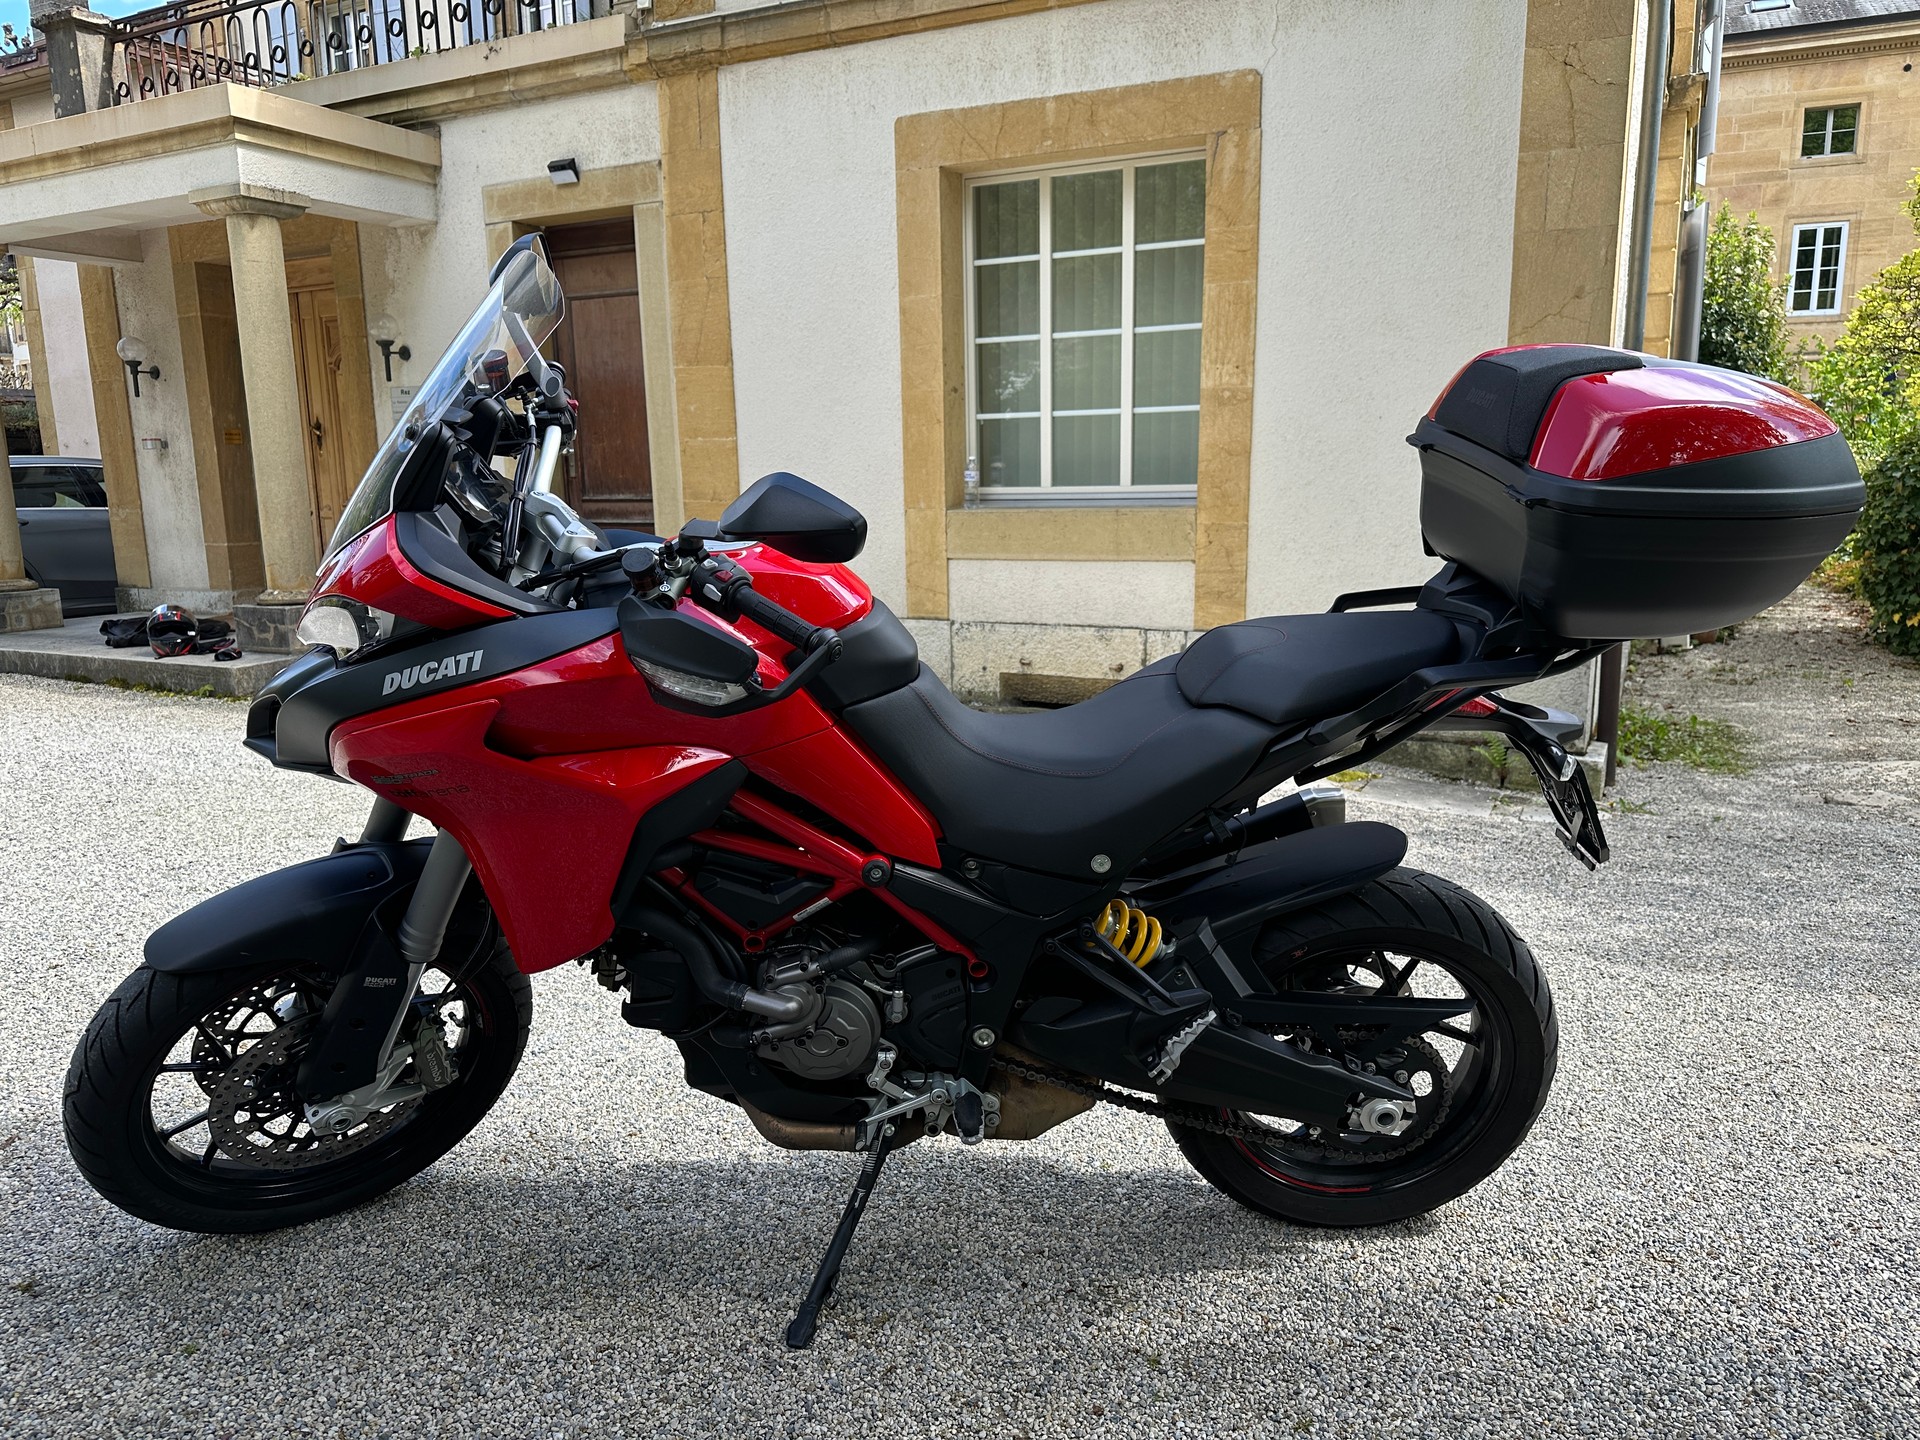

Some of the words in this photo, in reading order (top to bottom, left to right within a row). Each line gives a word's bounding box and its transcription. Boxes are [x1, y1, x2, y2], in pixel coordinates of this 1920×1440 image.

[382, 649, 484, 696] DUCATI
[364, 976, 397, 985] DUCATI
[426, 1051, 442, 1082] brembo
